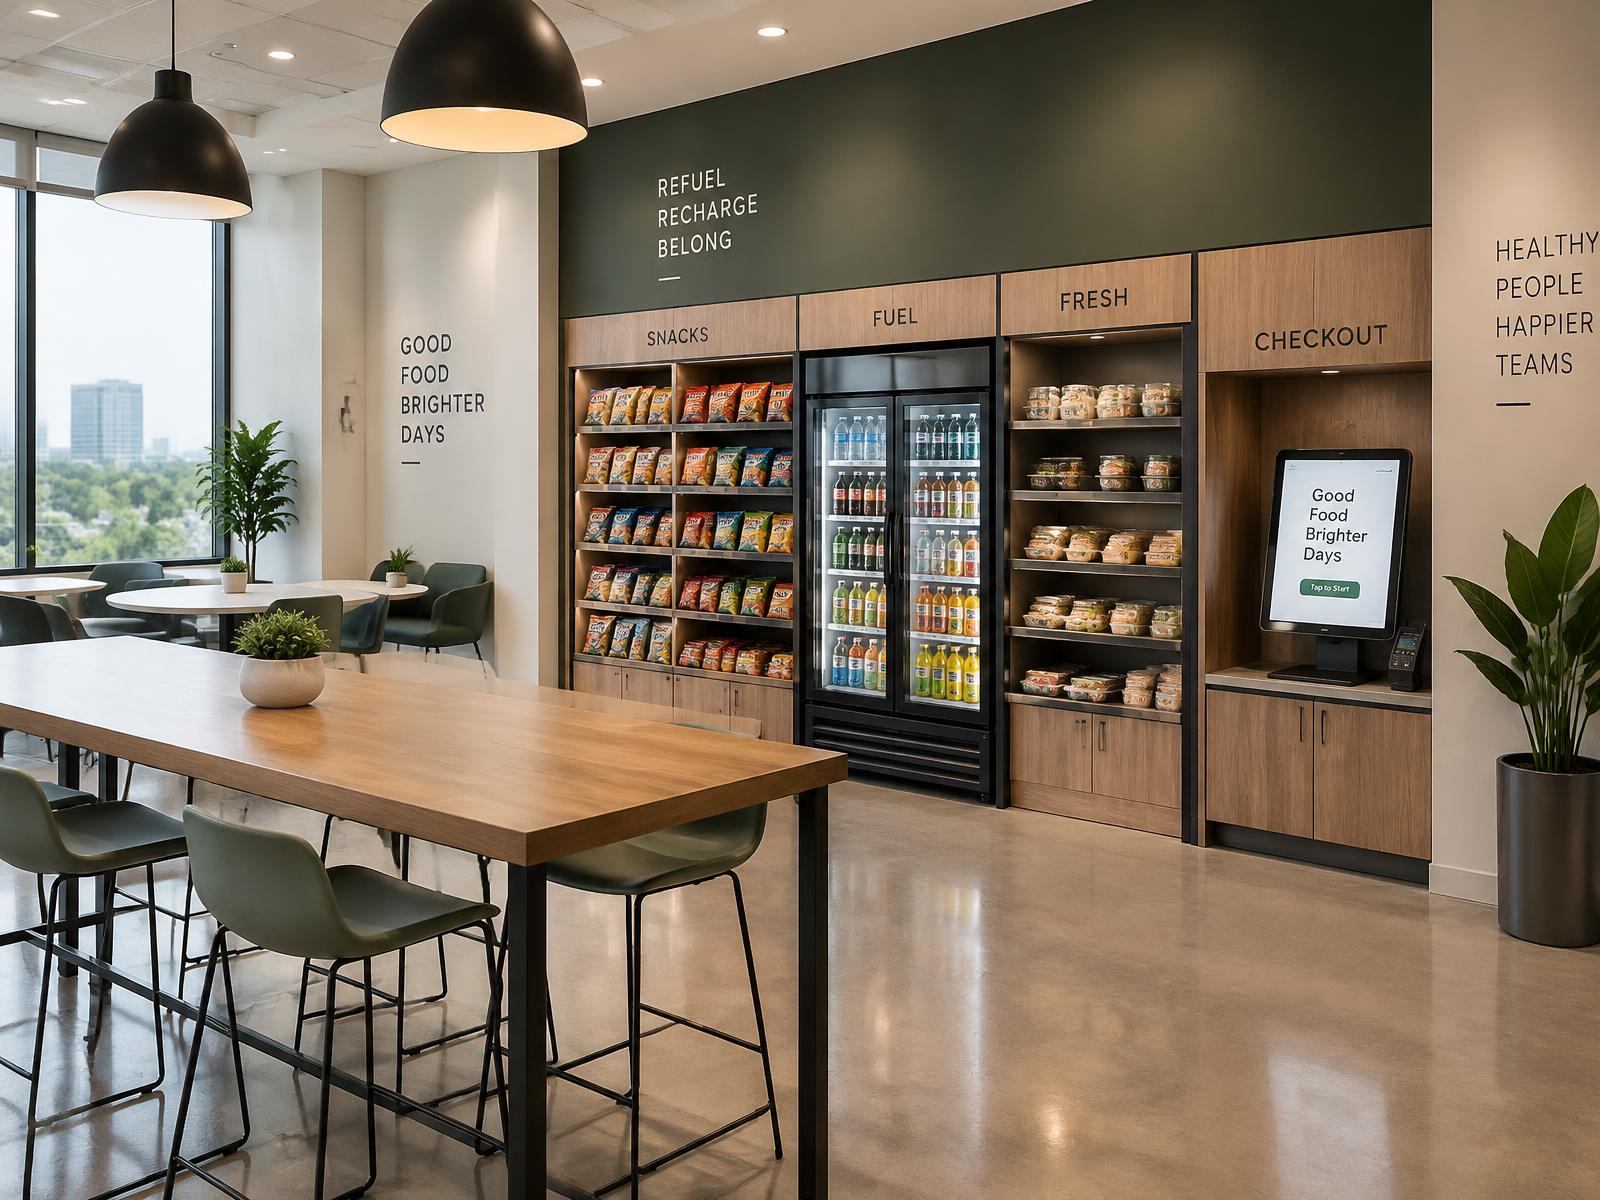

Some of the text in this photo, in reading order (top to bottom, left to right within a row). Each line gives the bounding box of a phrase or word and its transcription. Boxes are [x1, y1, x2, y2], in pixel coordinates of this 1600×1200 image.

[658, 168, 726, 198] REFUEL
[658, 193, 758, 228] RECHARGE
[658, 230, 732, 258] BELONG
[1496, 231, 1600, 262] HEALTHY
[1496, 272, 1583, 300] PEOPLE
[1060, 288, 1128, 311] FRESH
[873, 307, 918, 327] FUEL
[1496, 311, 1594, 338] HAPPIER
[400, 333, 452, 355] GOOD
[647, 326, 709, 346] SNACKS
[1254, 324, 1388, 352] CHECKOUT
[401, 364, 449, 384] FOOD
[1495, 352, 1573, 376] TEAMS
[401, 393, 485, 414] BRIGHTER
[401, 424, 445, 443] DAYS
[1312, 488, 1355, 502] Good
[1309, 507, 1348, 522] Food
[1305, 526, 1368, 544] Brighter
[1303, 546, 1342, 565] Days
[1311, 583, 1350, 593] Tap to Start
